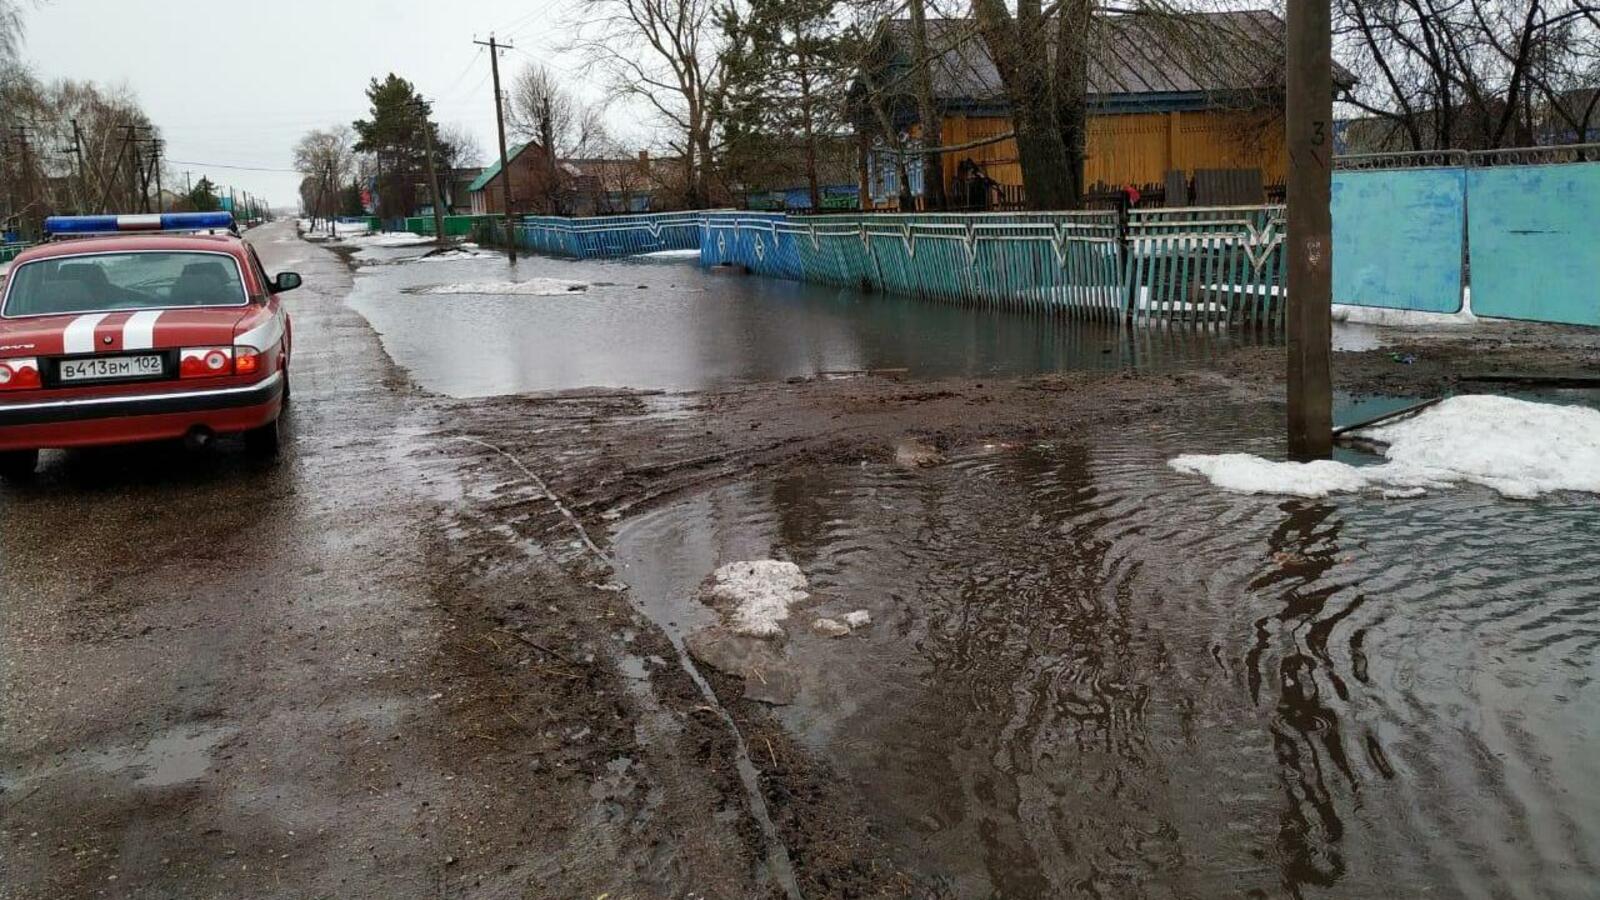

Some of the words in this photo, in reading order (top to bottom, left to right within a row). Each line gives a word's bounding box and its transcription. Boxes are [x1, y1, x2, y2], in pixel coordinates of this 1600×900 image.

[1311, 121, 1325, 146] 3
[64, 361, 130, 378] В413ВМ
[134, 357, 161, 368] 102
